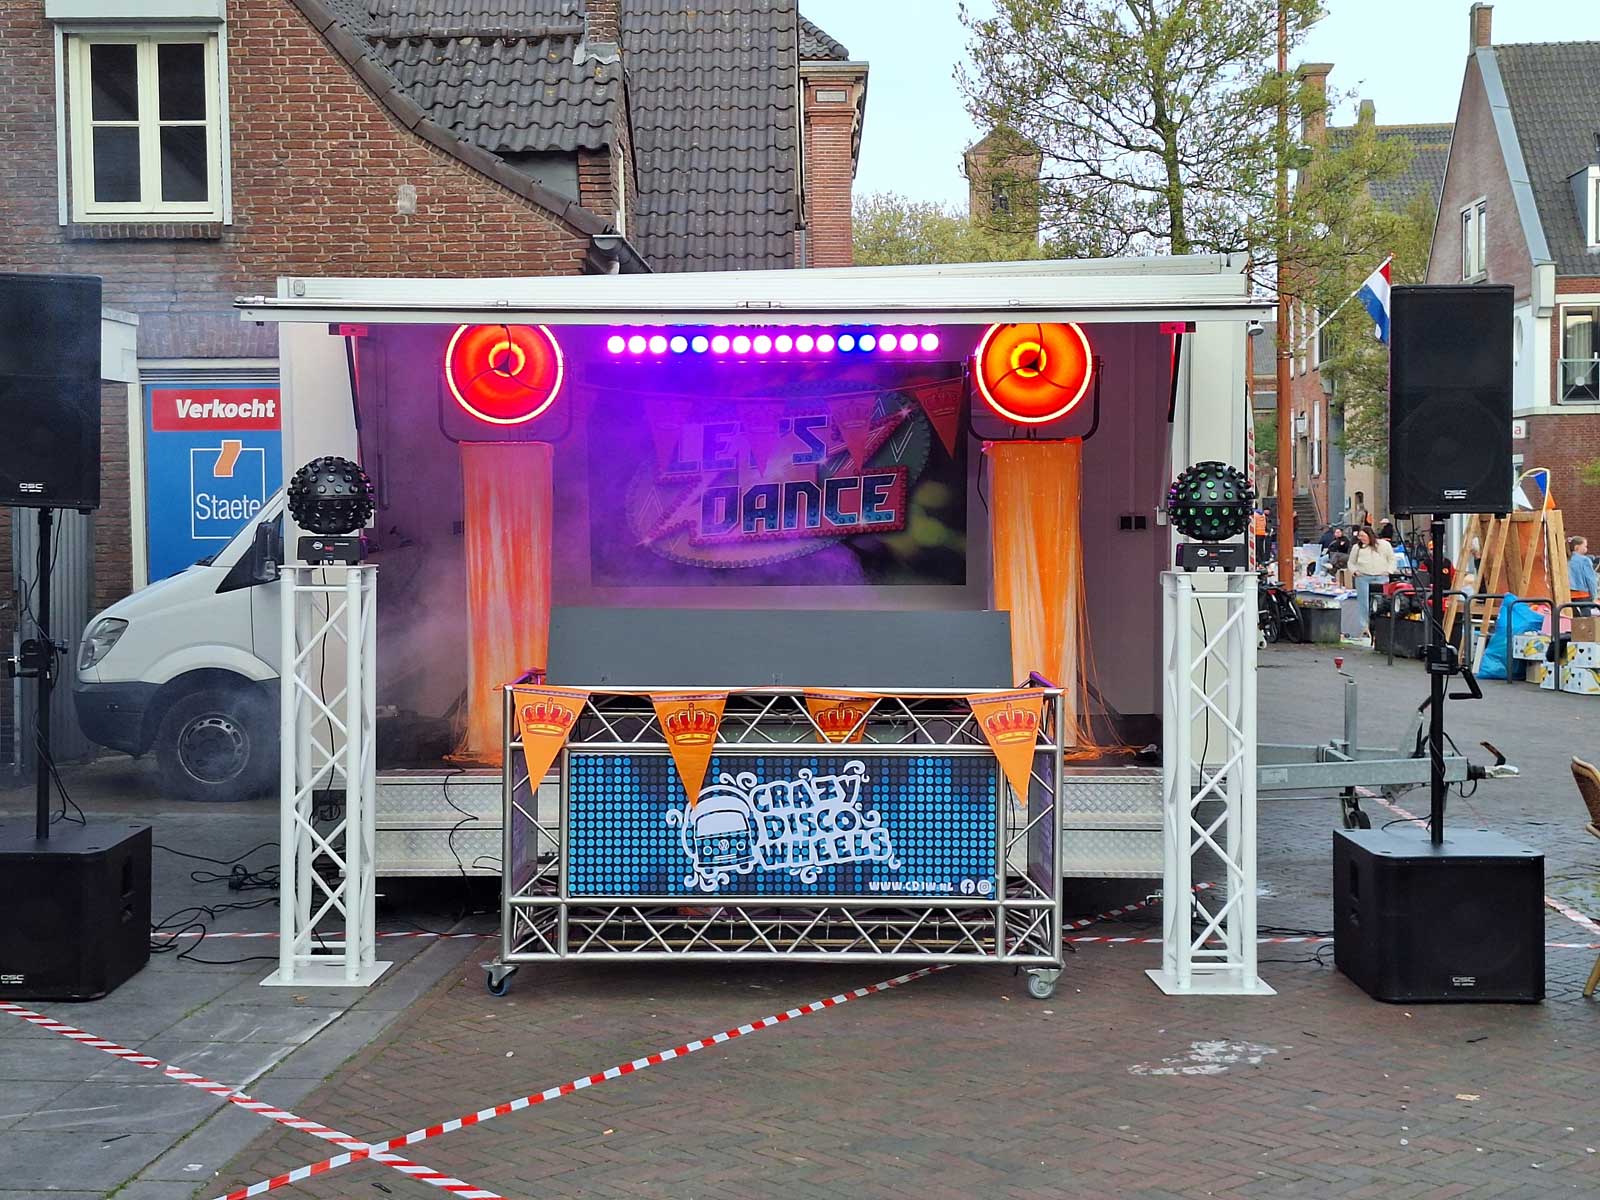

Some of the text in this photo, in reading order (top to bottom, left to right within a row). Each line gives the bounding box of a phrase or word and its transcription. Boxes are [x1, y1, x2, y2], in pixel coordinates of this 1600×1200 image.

[175, 398, 276, 419] Verkocht
[663, 414, 829, 475] LE'S
[701, 473, 897, 537] DANCE
[752, 777, 858, 813] CRAZY
[763, 808, 857, 841] DISCO
[759, 831, 889, 866] WHEELS
